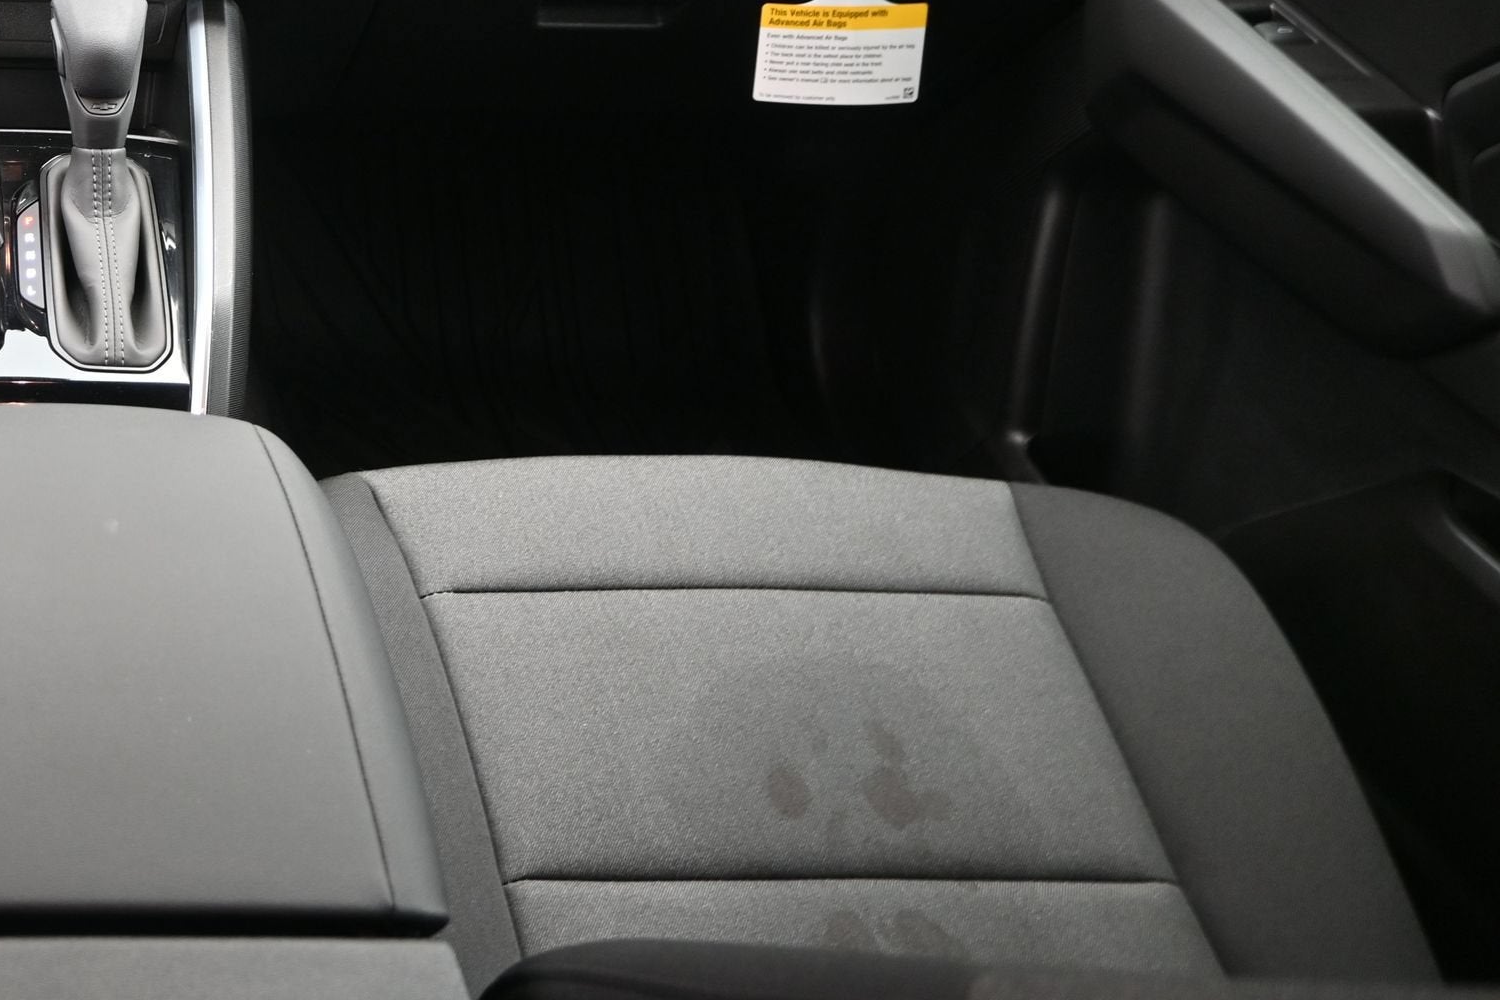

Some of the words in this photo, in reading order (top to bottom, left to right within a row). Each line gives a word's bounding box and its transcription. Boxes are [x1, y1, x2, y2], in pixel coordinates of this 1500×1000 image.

[770, 8, 788, 16] This
[790, 9, 820, 17] Vehicle
[822, 10, 830, 18] is
[832, 10, 869, 19] Equipped
[871, 9, 889, 17] with
[768, 18, 811, 27] Advanced
[812, 19, 825, 27] Air
[826, 20, 847, 29] Bags
[25, 216, 33, 225] P
[24, 232, 35, 243] R
[26, 268, 36, 278] D
[27, 285, 36, 296] L
